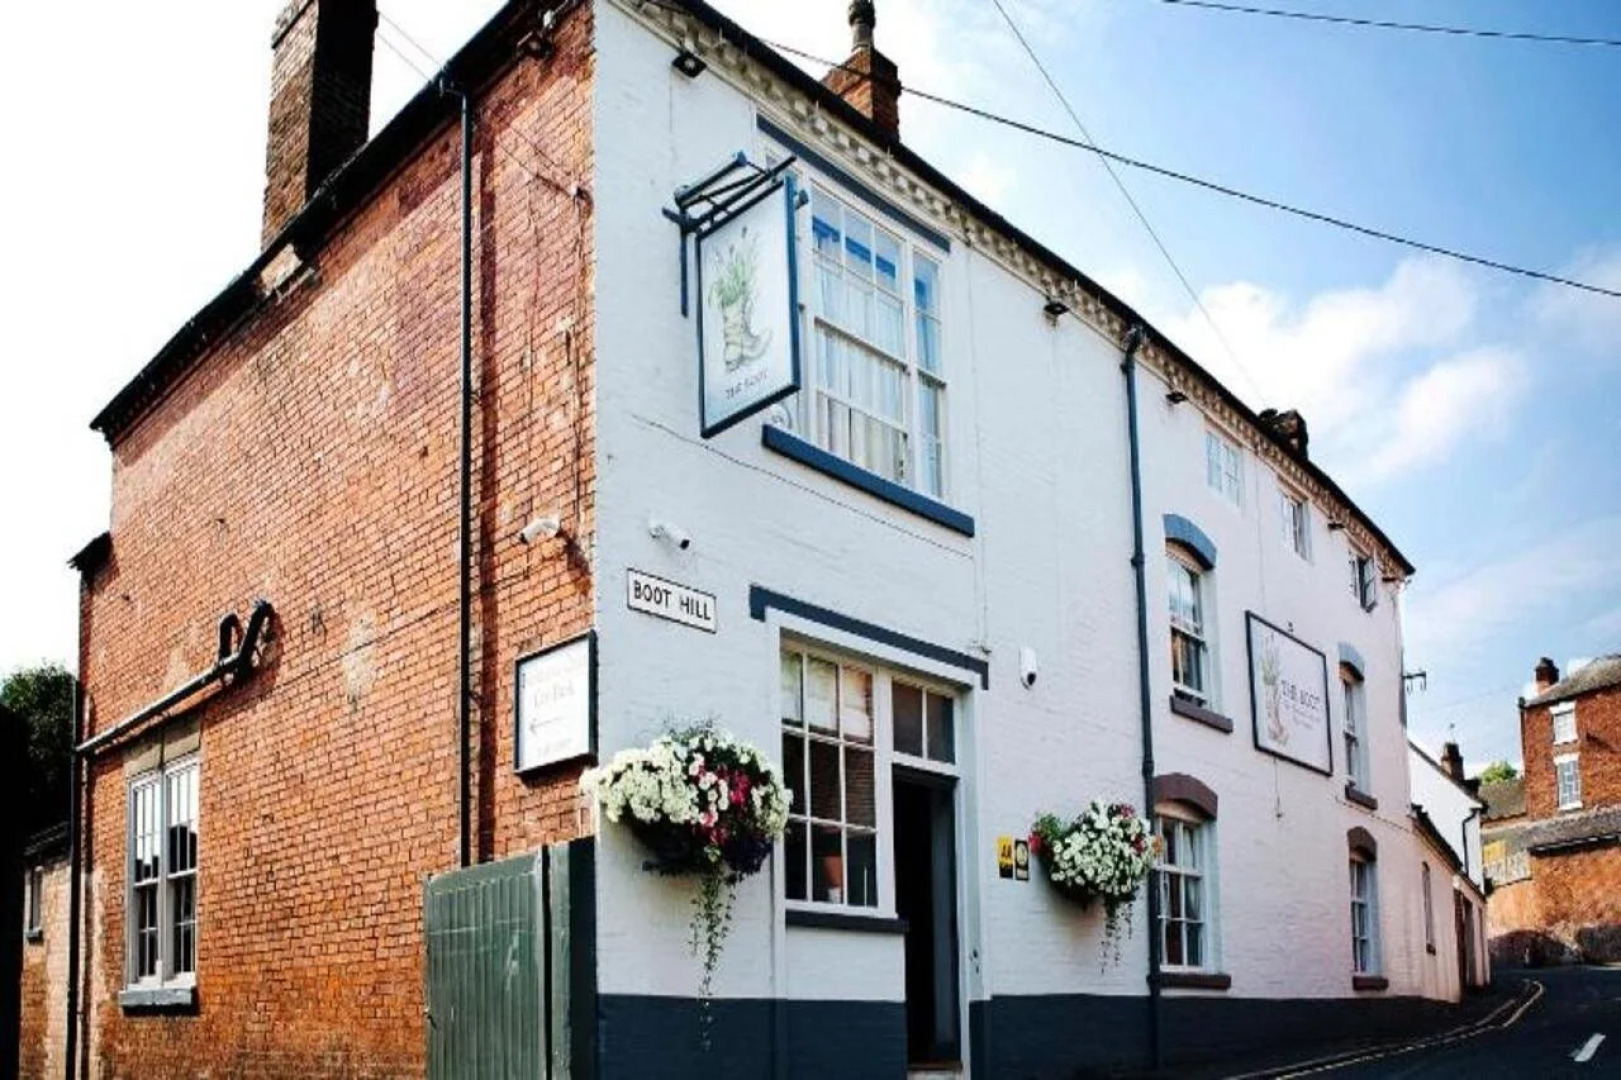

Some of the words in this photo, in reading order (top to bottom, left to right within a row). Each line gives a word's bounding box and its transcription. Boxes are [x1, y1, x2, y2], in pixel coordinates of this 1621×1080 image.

[633, 579, 671, 609] BOOT
[680, 594, 711, 621] HILL
[1281, 679, 1297, 700] THE
